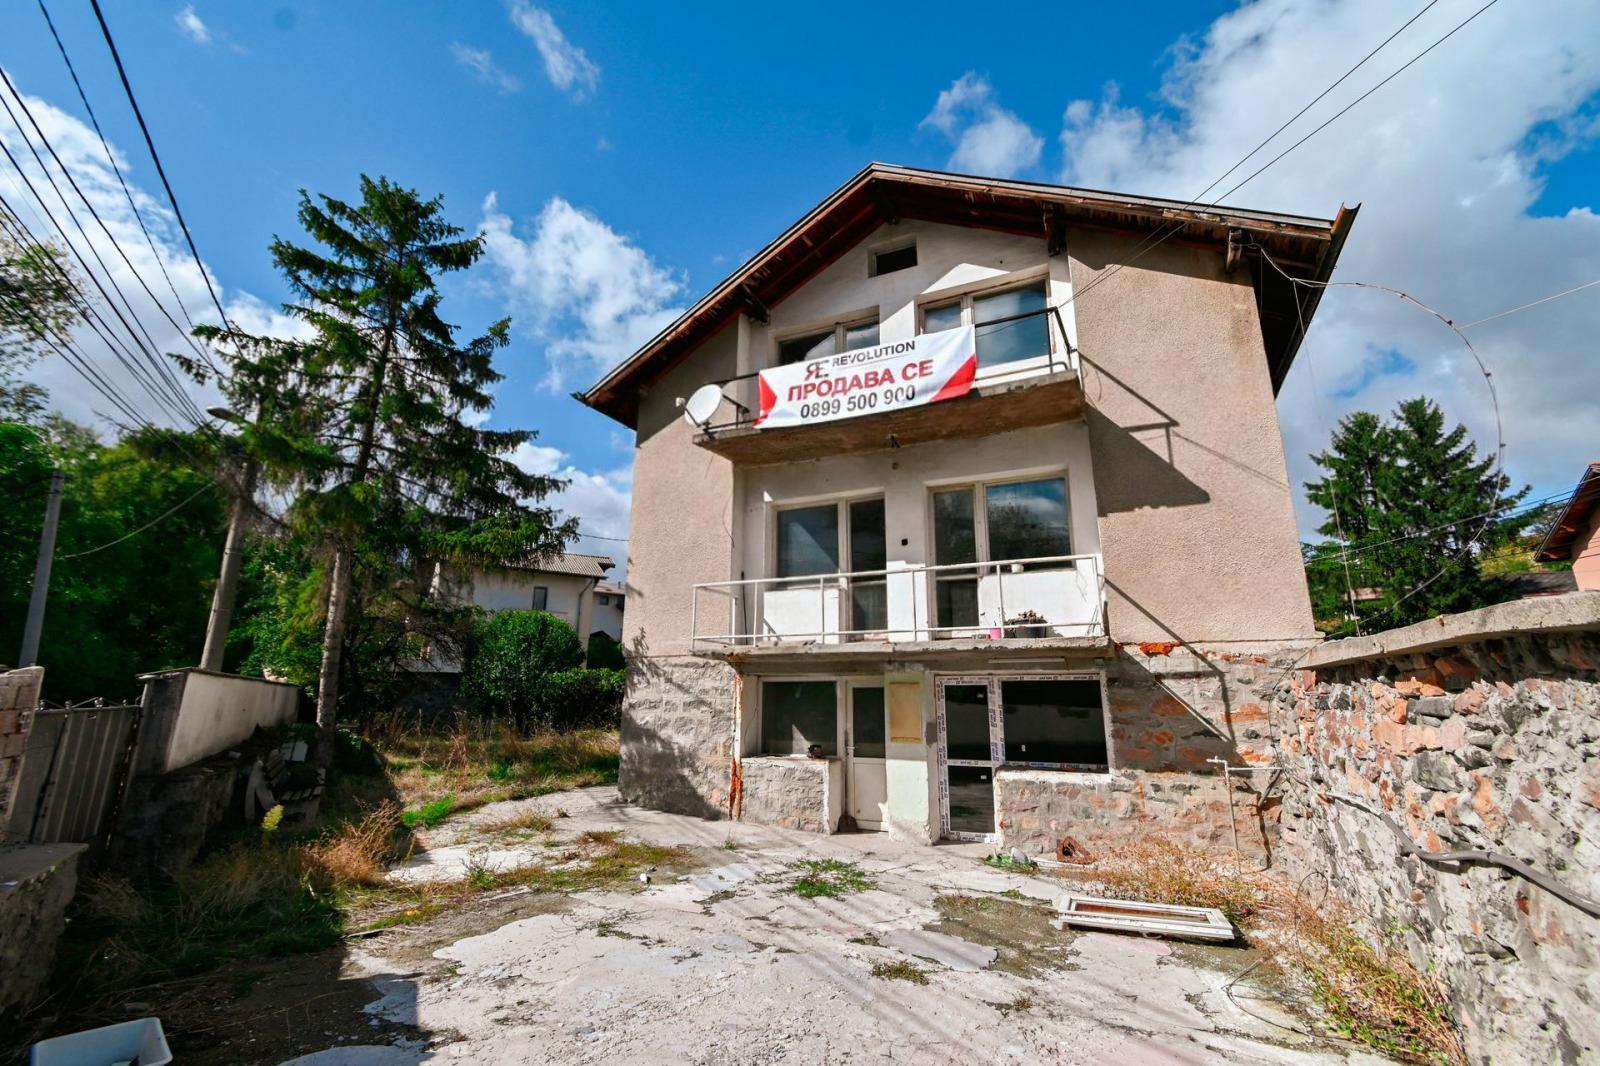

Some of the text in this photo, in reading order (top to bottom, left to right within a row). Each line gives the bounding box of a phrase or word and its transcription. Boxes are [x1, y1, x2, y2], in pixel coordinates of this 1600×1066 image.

[832, 341, 916, 367] REVOLUTION
[787, 359, 933, 401] ПРОДАВА СЕ
[800, 384, 916, 419] 0899 500 900
